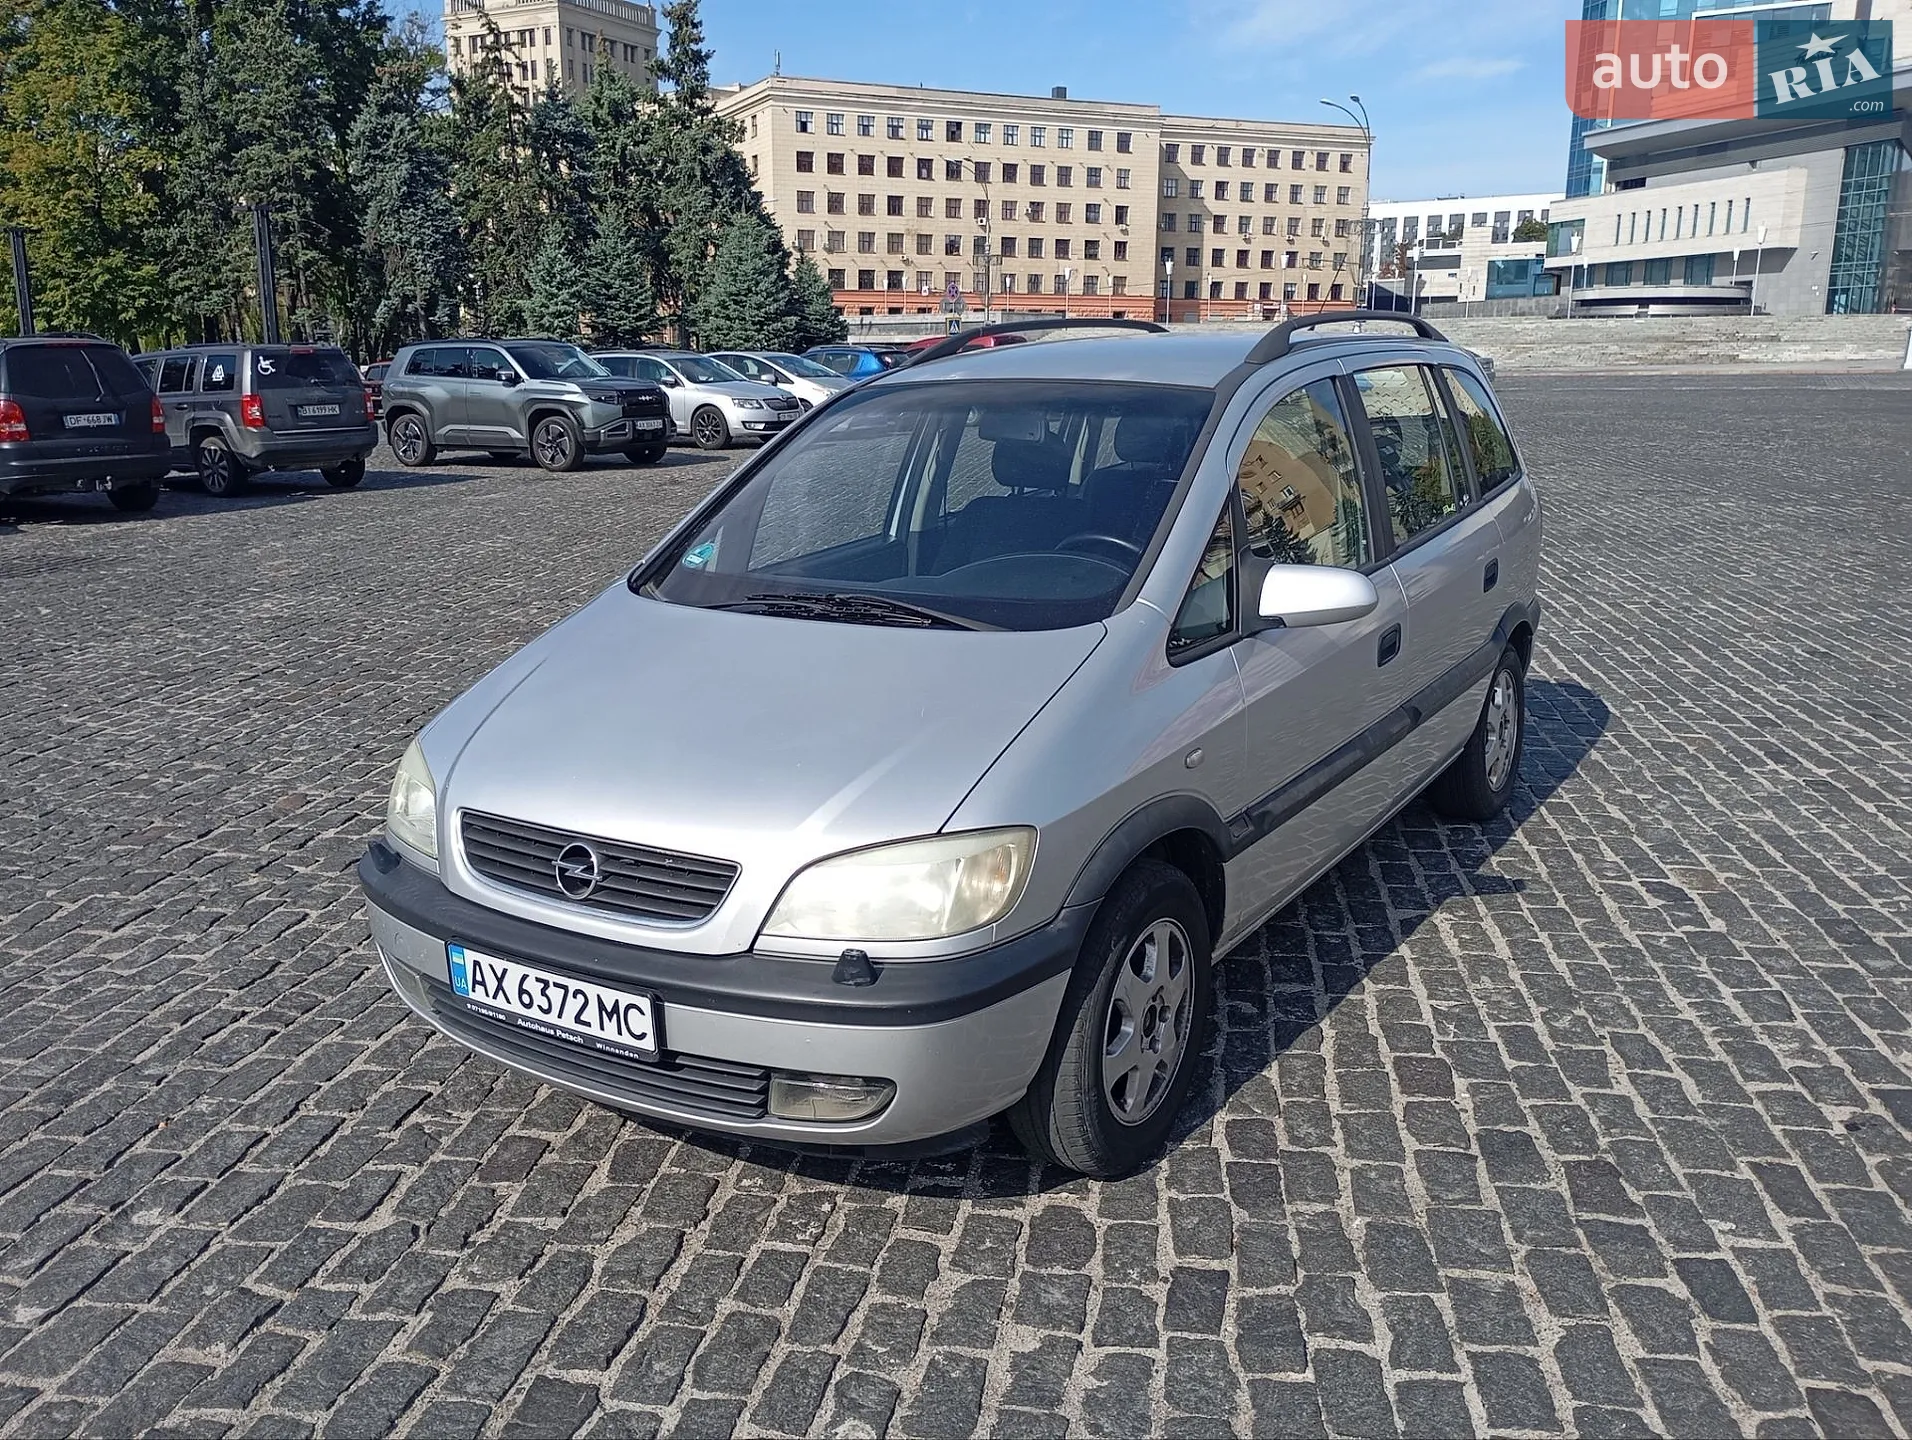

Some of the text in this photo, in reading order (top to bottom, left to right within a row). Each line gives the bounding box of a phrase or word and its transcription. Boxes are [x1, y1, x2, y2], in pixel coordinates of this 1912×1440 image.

[454, 975, 468, 990] UA
[471, 959, 648, 1041] AX 6372 MC
[516, 1018, 555, 1035] Autohaus
[556, 1029, 584, 1044] Petsch
[595, 1042, 639, 1059] Winnenden
